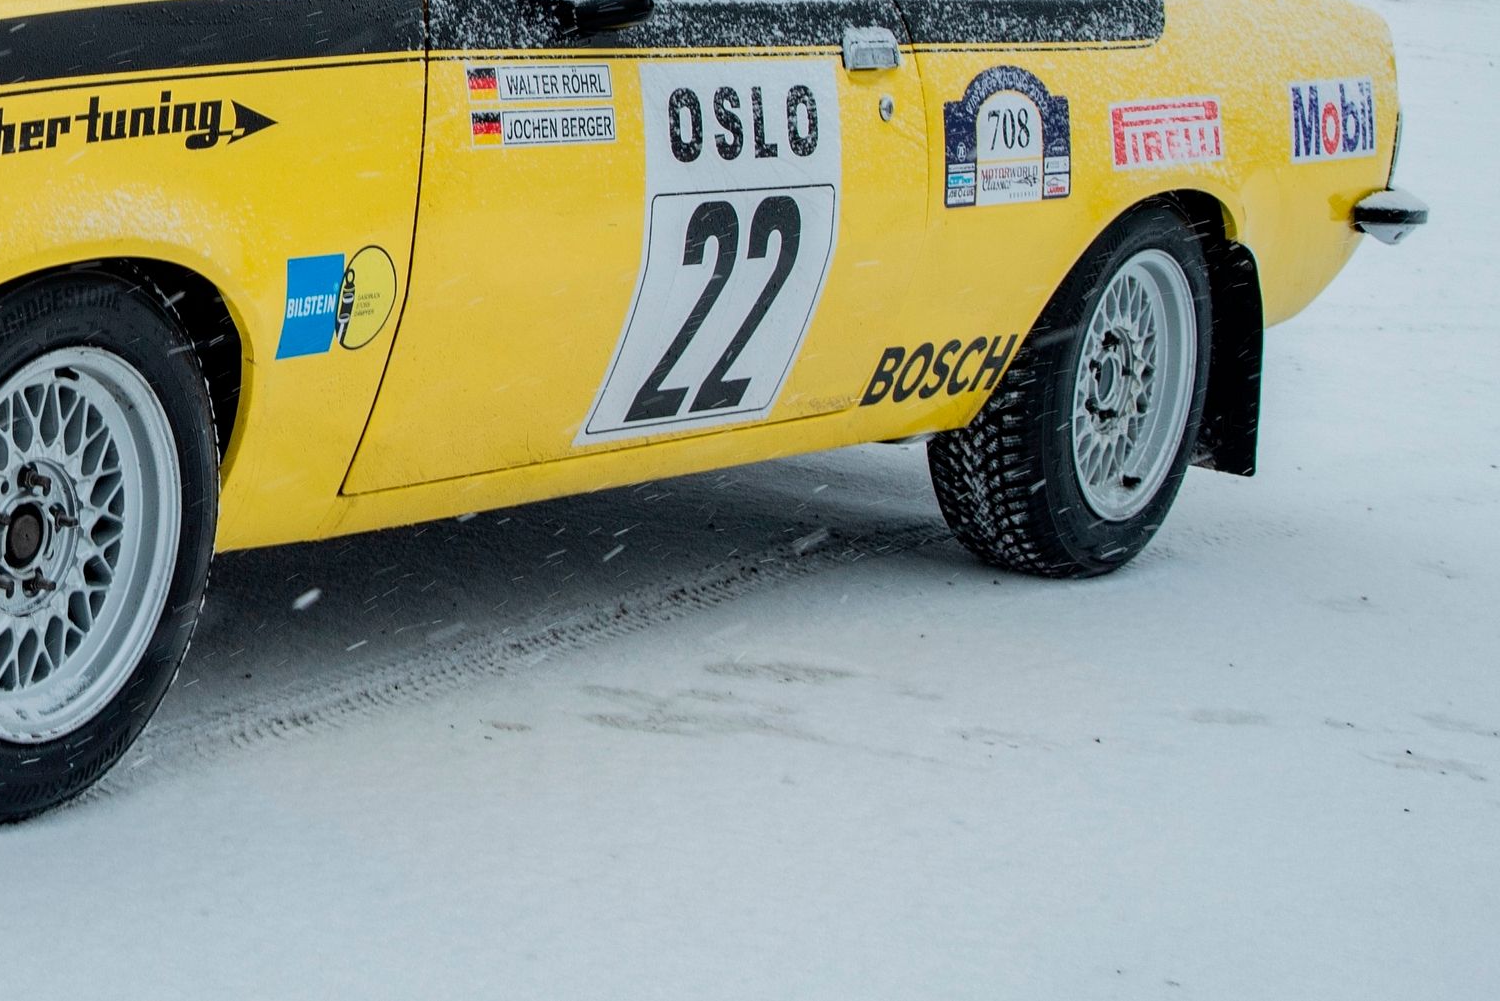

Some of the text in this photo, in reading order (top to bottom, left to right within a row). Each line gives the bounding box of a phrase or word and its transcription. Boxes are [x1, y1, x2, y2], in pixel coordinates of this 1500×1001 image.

[506, 68, 605, 95] WALTER RÖHRL
[507, 116, 612, 140] JOCHEN BERGER
[667, 84, 819, 163] OSLO
[988, 108, 1030, 151] 708
[1111, 99, 1222, 165] PIRELLI
[1291, 81, 1375, 158] Mobil
[286, 293, 336, 319] BILSTEIN
[622, 196, 802, 423] 22
[859, 334, 1017, 407] BOSCH
